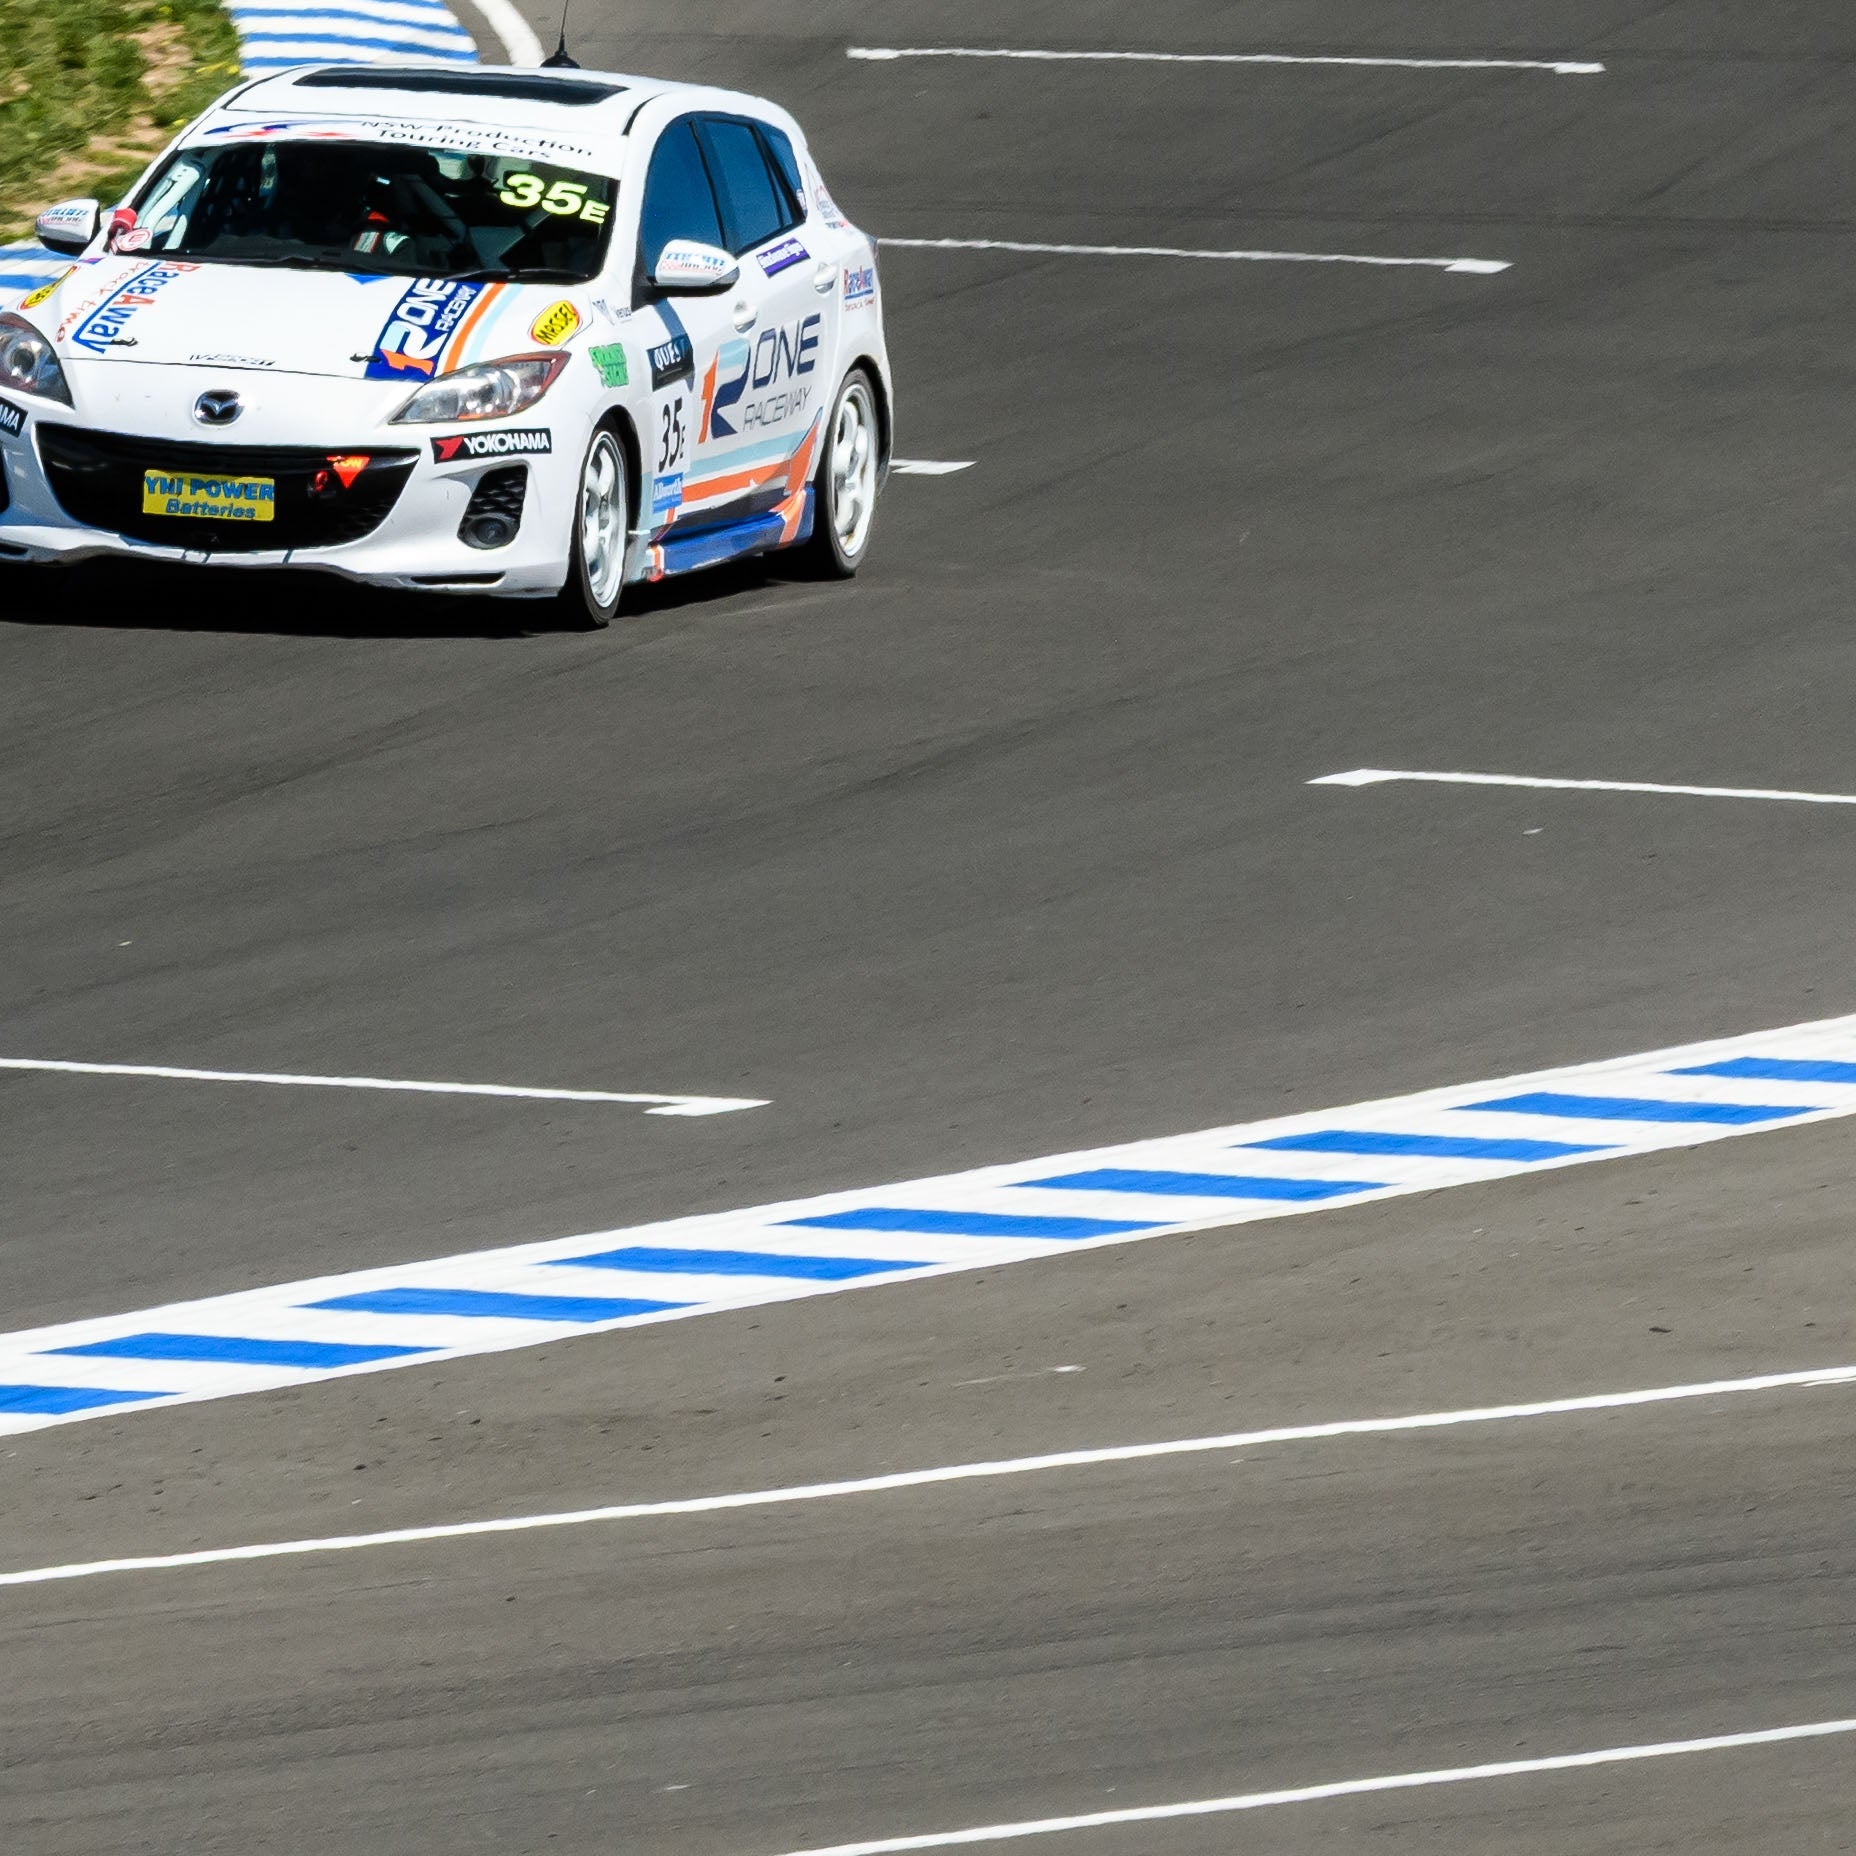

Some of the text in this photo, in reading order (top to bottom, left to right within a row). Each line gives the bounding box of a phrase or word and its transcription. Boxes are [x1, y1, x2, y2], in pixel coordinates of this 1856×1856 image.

[492, 142, 550, 158] Cars
[72, 261, 204, 354] RaceAway
[752, 312, 821, 390] ONE
[463, 432, 550, 454] YOKOHAMA
[190, 478, 274, 501] POWER
[166, 498, 256, 518] Batteries
